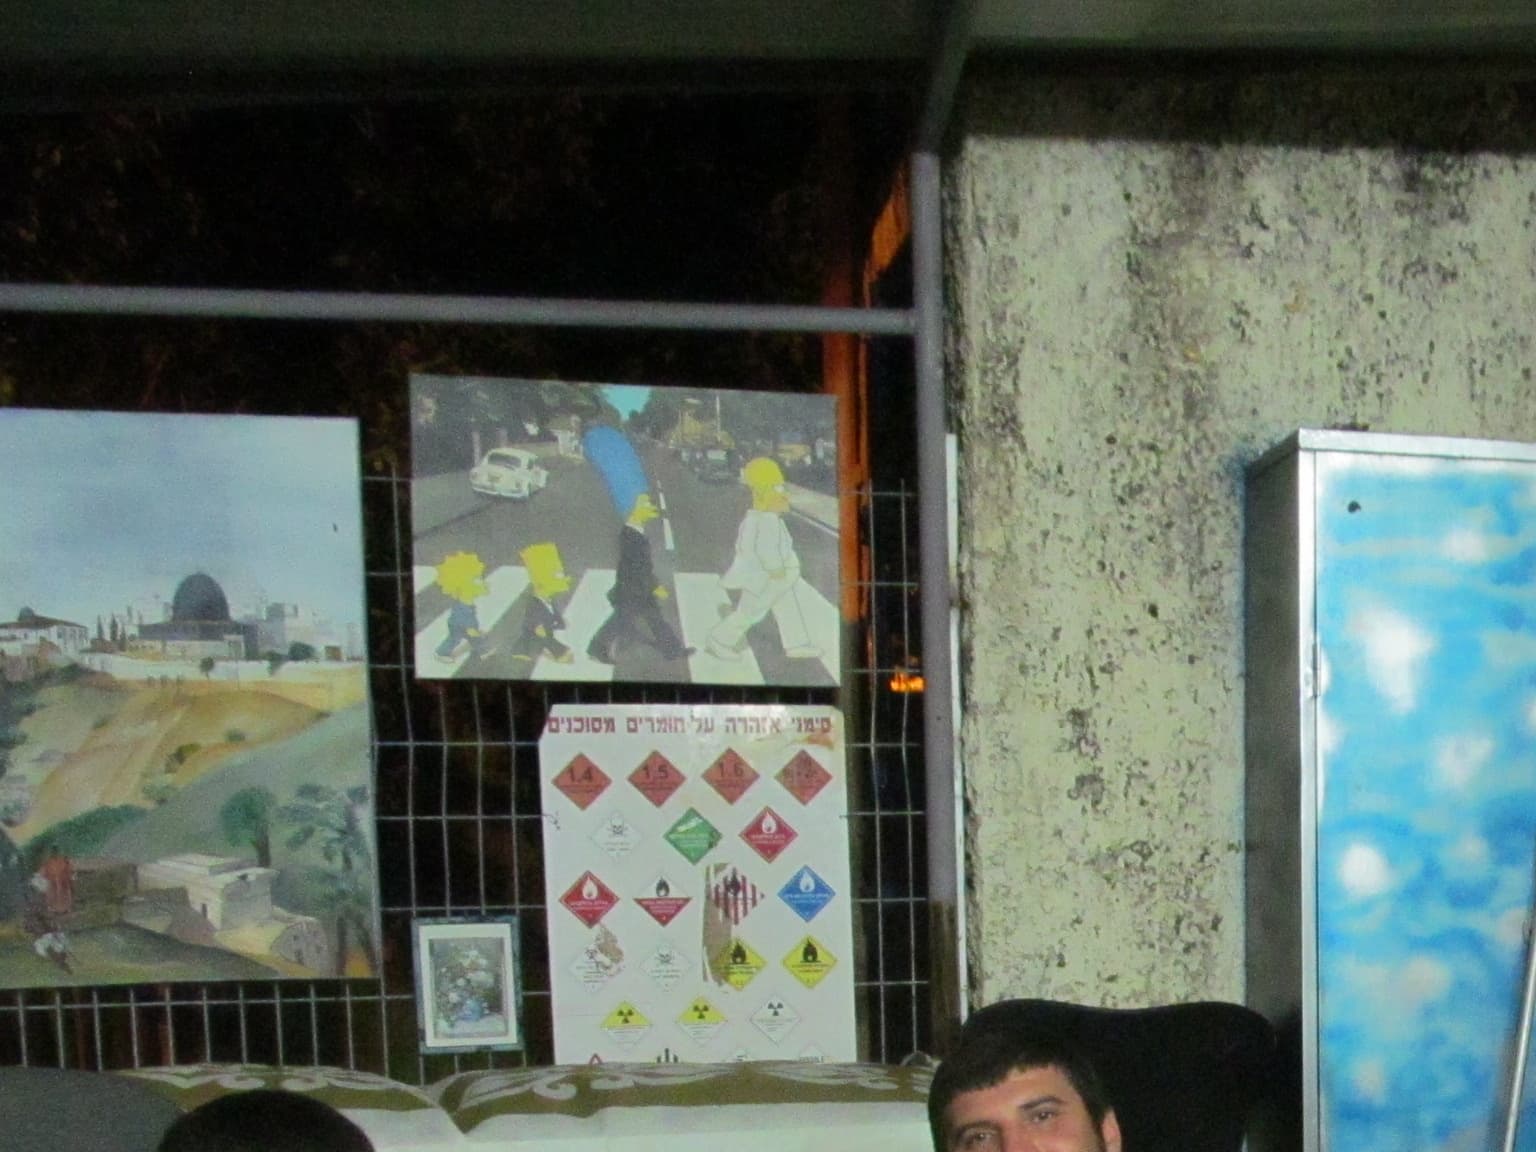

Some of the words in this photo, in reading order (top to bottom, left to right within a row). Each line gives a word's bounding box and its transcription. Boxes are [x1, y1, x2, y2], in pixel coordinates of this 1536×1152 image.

[547, 717, 615, 733] מסוכנים
[626, 717, 686, 733] חומרים
[691, 711, 714, 733] על
[725, 716, 781, 734] אזהרה
[792, 716, 832, 733] סימני
[569, 765, 593, 783] 1.4
[642, 764, 668, 780] 1.5
[719, 761, 745, 777] 1.6
